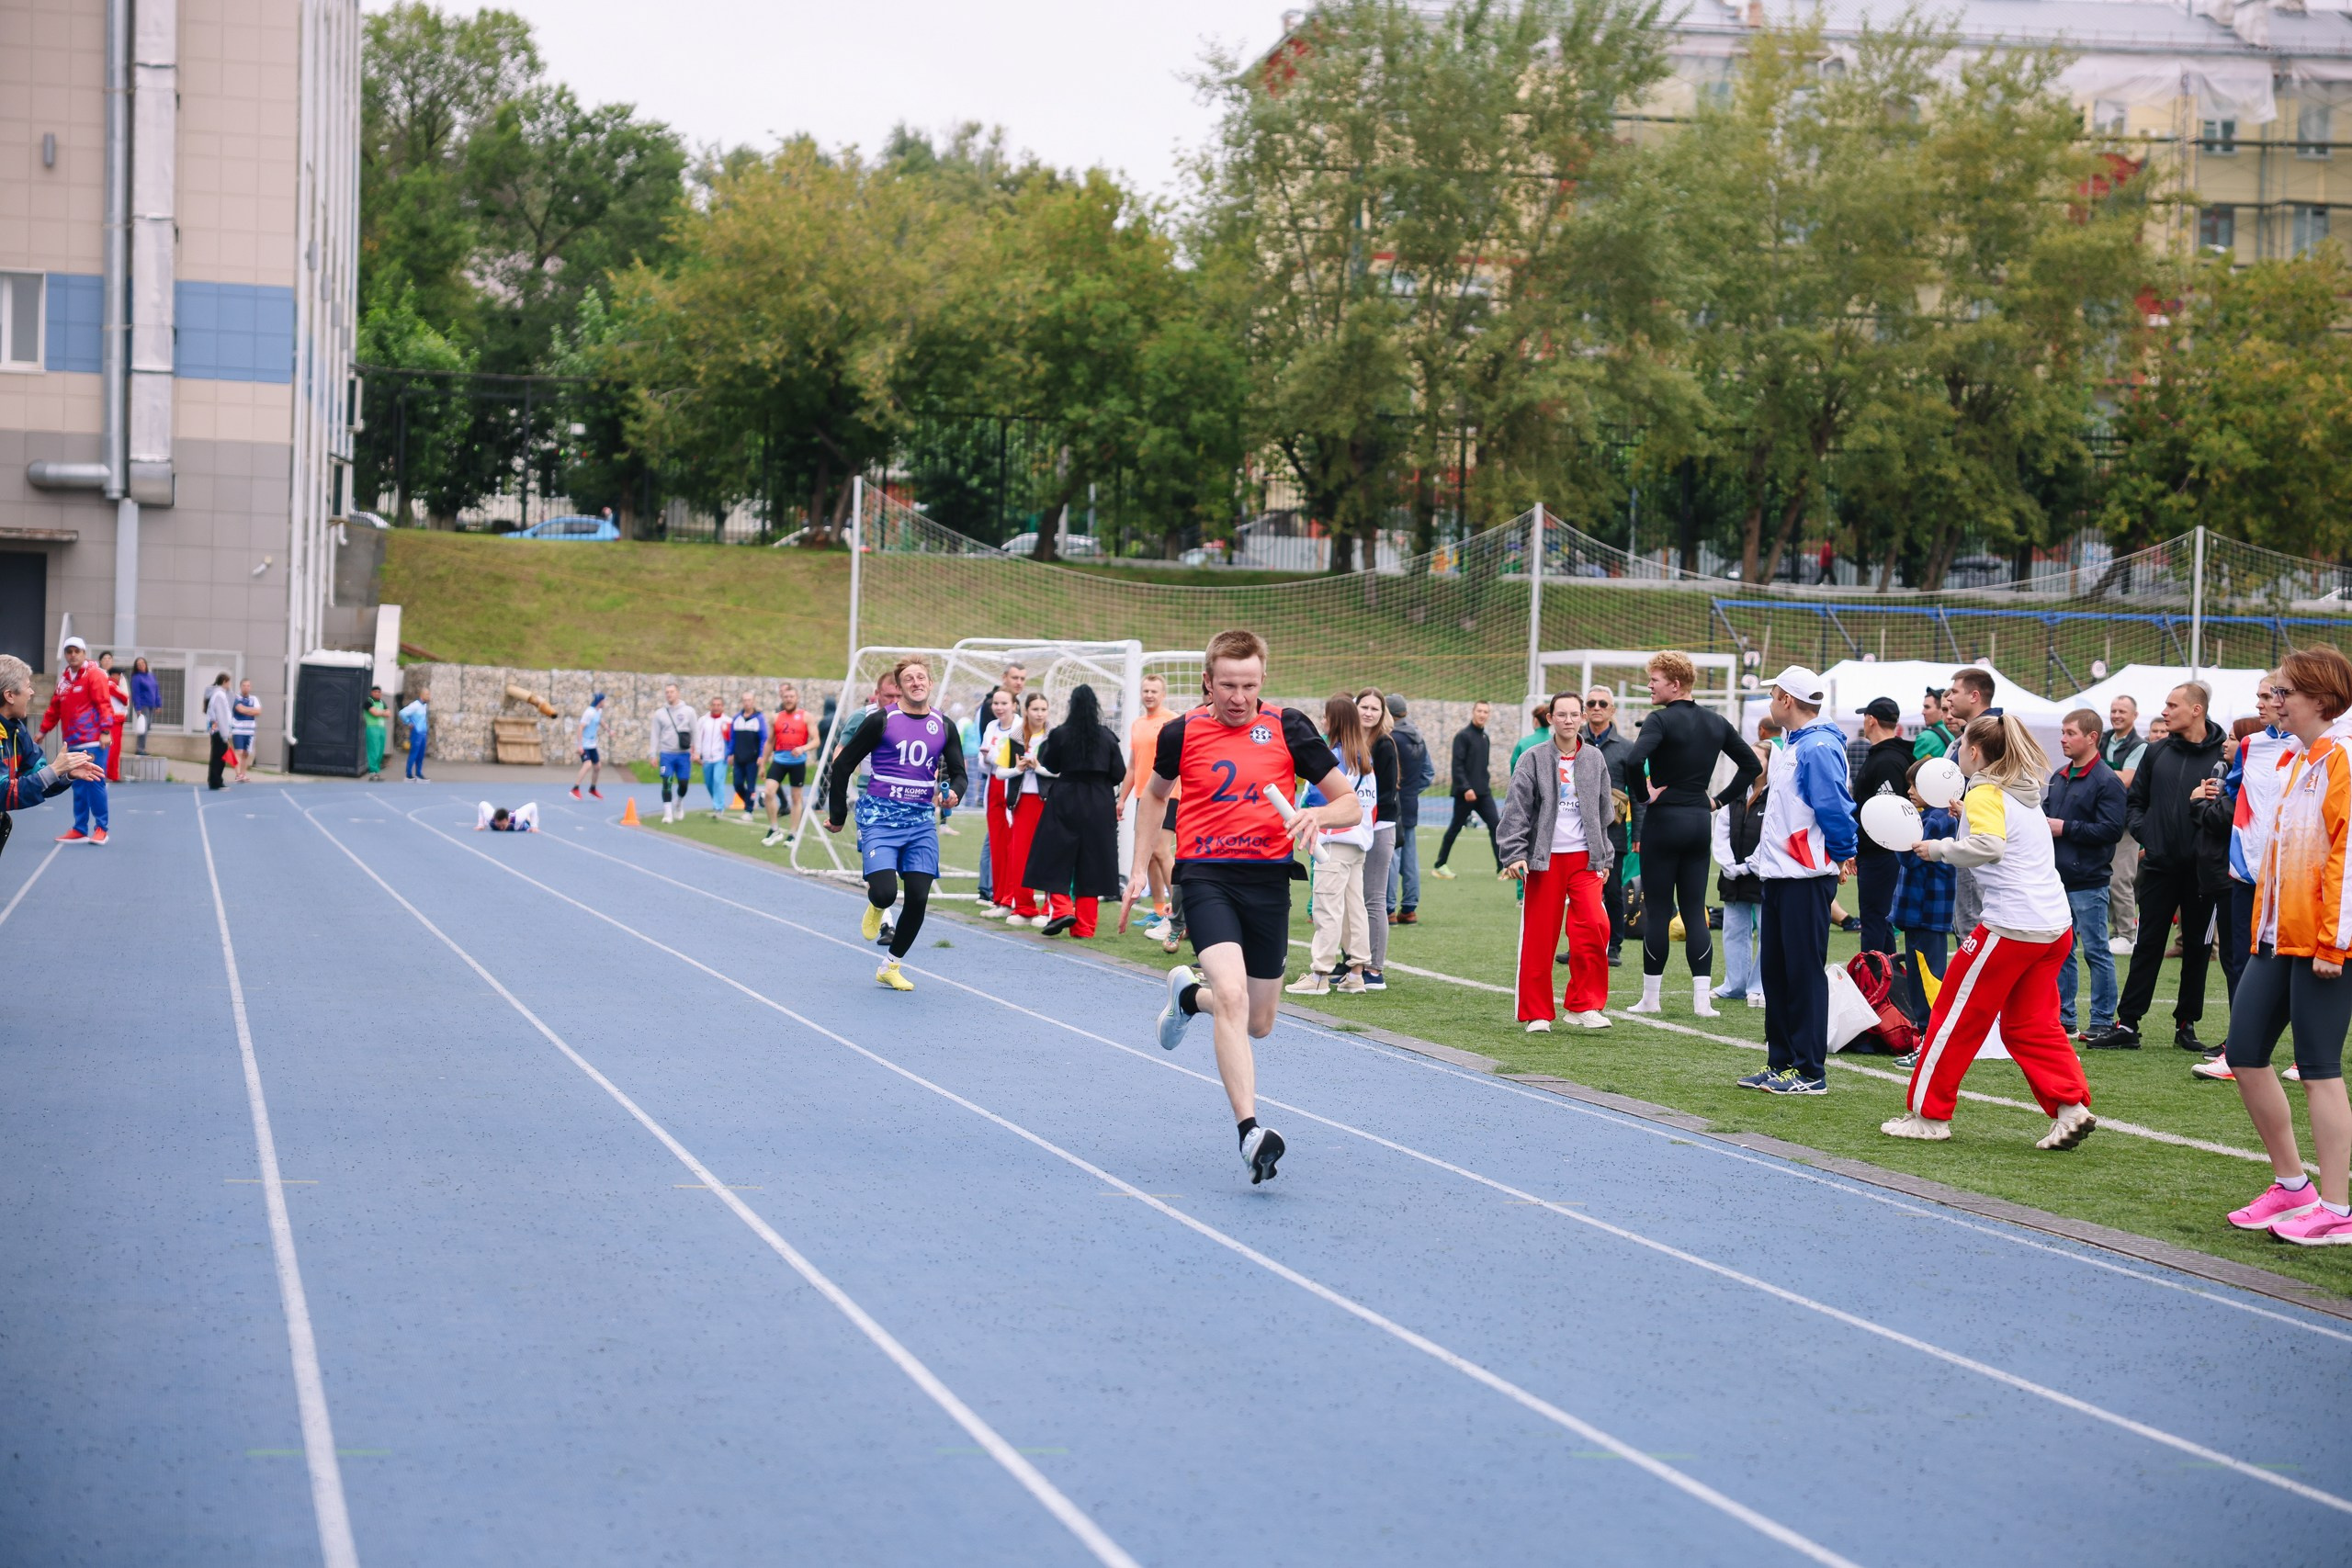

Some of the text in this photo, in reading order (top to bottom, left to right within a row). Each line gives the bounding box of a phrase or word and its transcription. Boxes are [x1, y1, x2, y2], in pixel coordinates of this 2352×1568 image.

[895, 739, 928, 767] 10
[1211, 760, 1260, 804] 2 4
[1216, 836, 1272, 848] КОМОС
